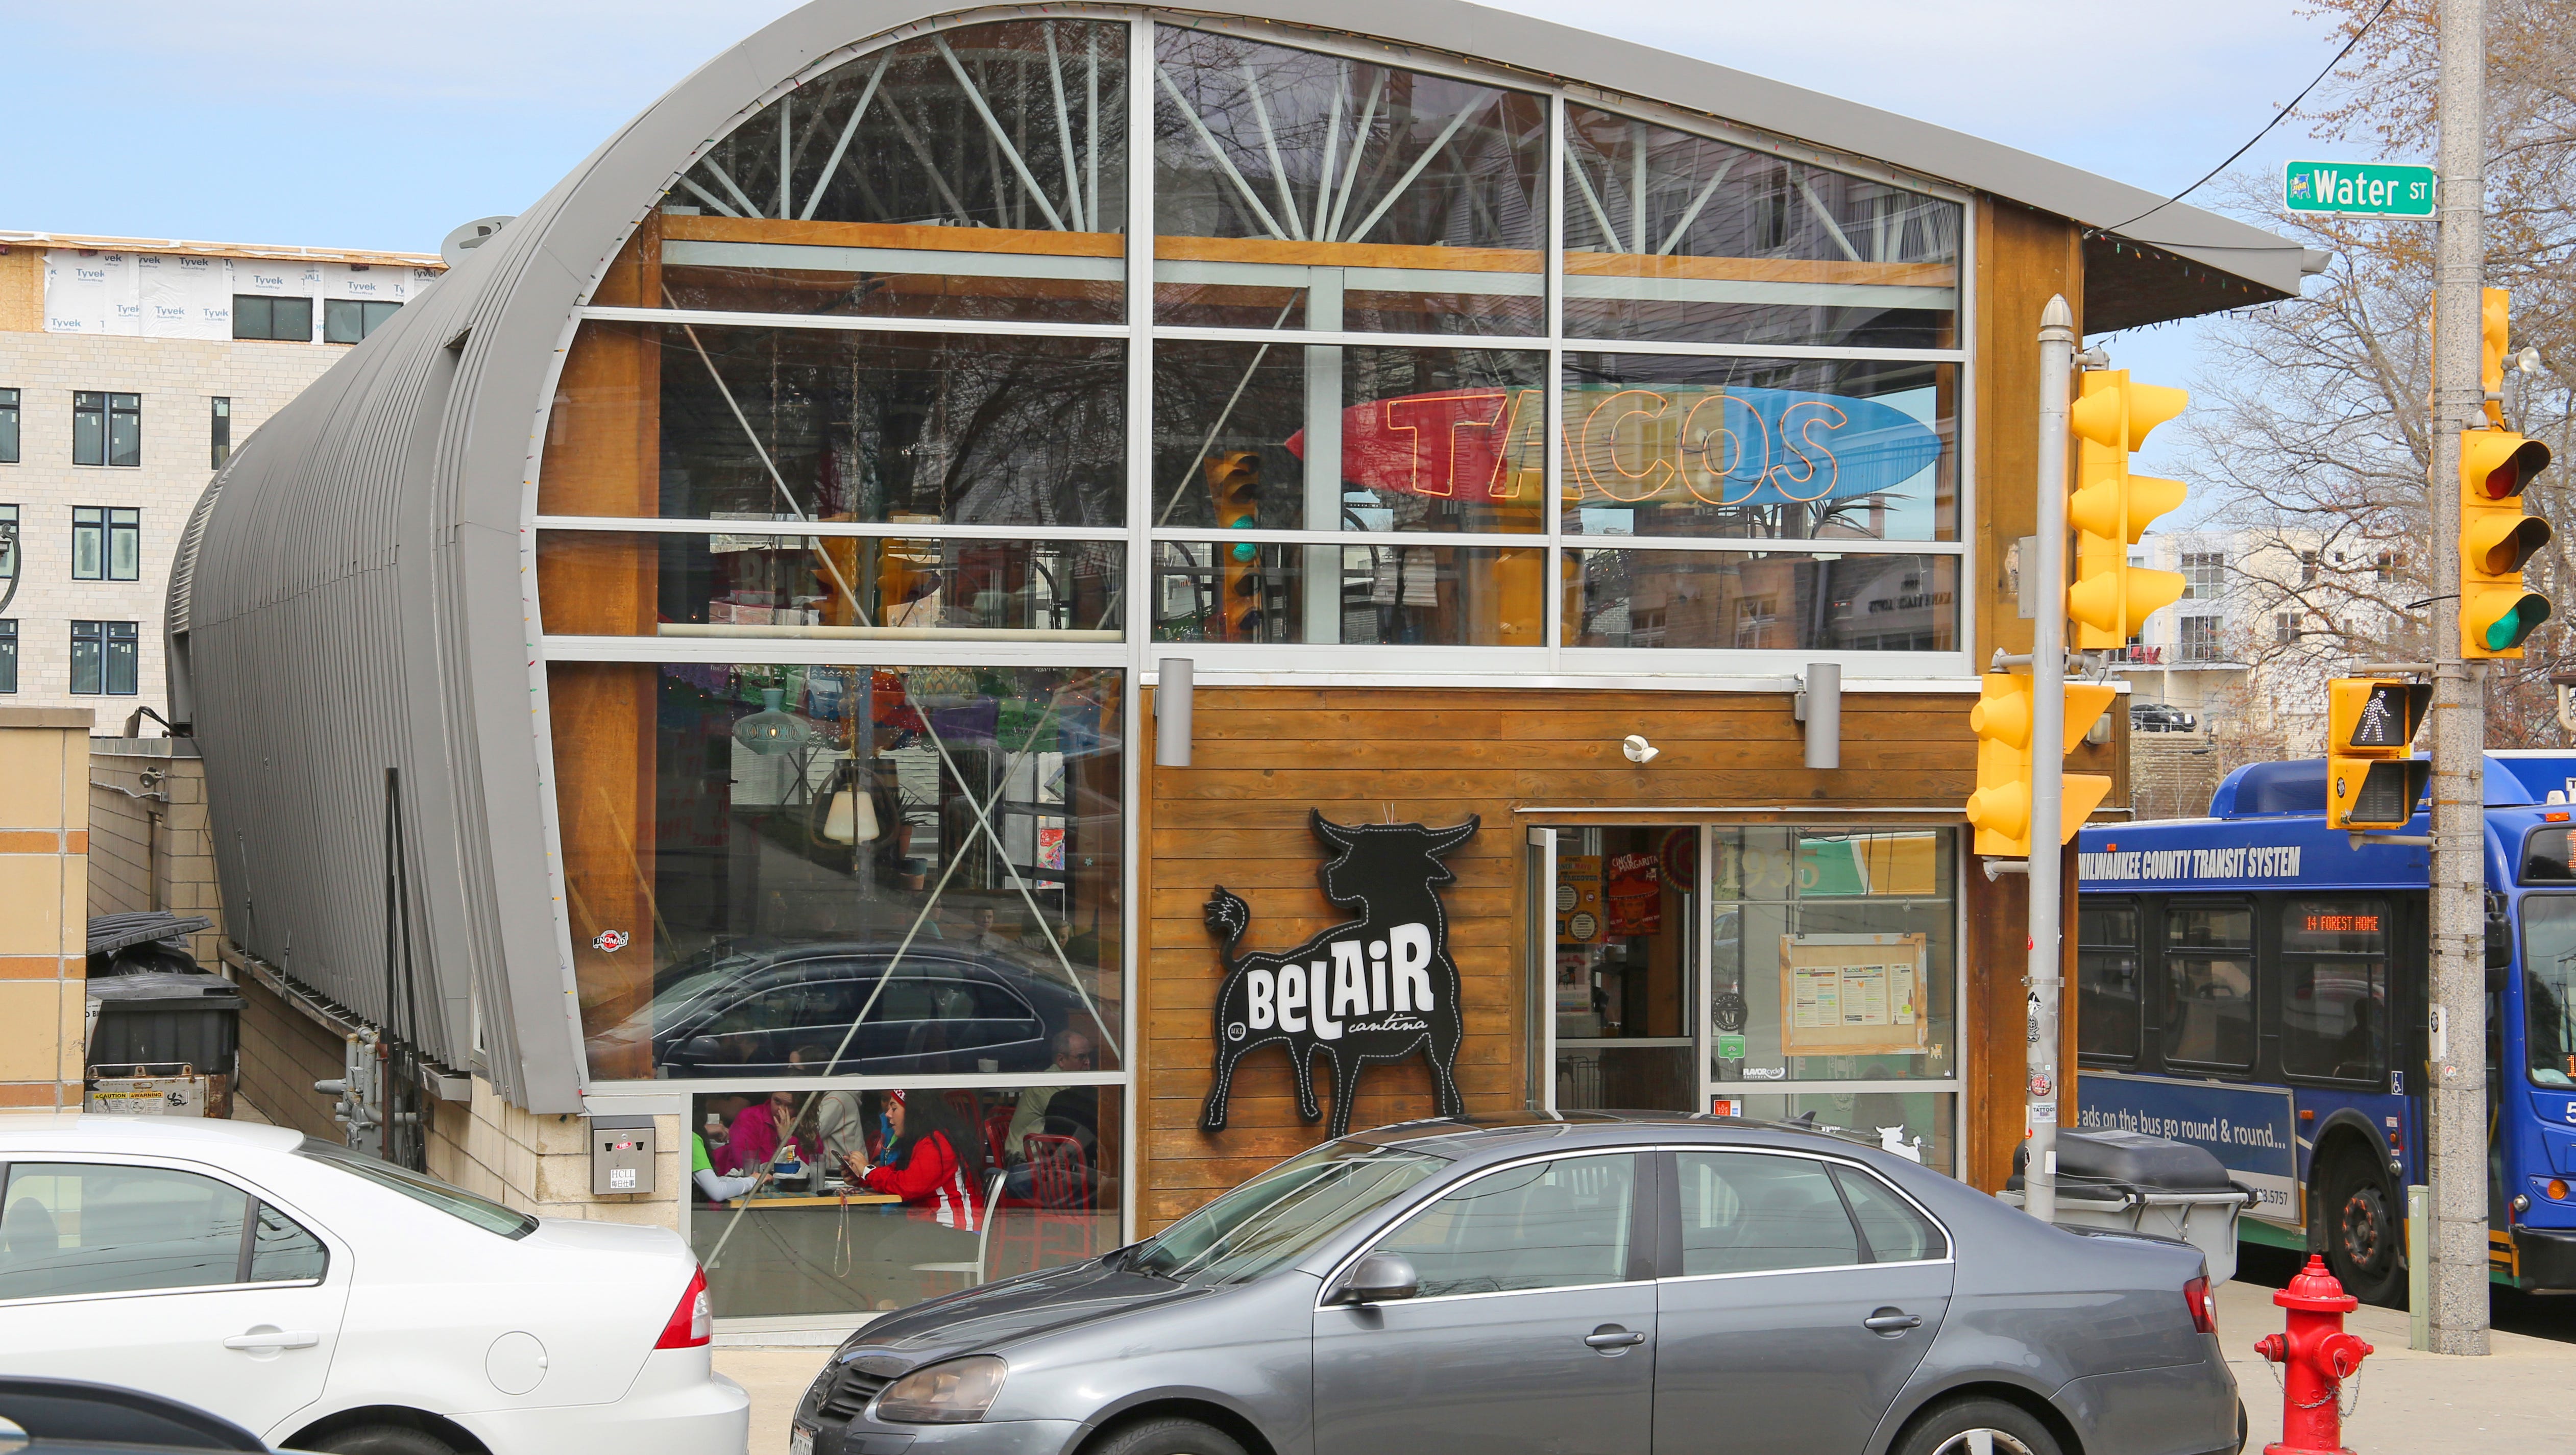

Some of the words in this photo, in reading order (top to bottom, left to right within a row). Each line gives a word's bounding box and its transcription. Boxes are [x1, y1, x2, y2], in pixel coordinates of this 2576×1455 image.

[2314, 169, 2399, 206] Water
[2410, 182, 2427, 200] ST
[179, 257, 208, 266] Tyvek
[254, 275, 283, 285] Tyvek
[348, 281, 376, 291] Tyvek
[155, 306, 185, 315] Tyvek
[51, 318, 81, 328] Tyvek
[1388, 389, 1847, 503] TACOS
[1612, 854, 1633, 867] CINCO
[1618, 855, 1659, 873] MARGARITA
[1720, 843, 1820, 890] 1935
[2078, 851, 2142, 880] MILWAUKEE
[2143, 850, 2191, 880] COUNTY
[2193, 848, 2246, 878] TRANSIT
[2248, 846, 2301, 878] SYSTEM
[2307, 916, 2317, 930] 14
[2321, 916, 2352, 930] FOREST
[2355, 916, 2378, 931] HOME
[600, 937, 625, 945] NOMAD
[1348, 1013, 1428, 1033] cantina
[1231, 1027, 1243, 1035] MKE
[2082, 1104, 2101, 1127] ads
[2103, 1112, 2117, 1127] on
[2119, 1108, 2137, 1132] the
[2140, 1109, 2161, 1135] bus
[2164, 1119, 2178, 1140] go
[2181, 1117, 2217, 1142] round
[2221, 1118, 2231, 1143] &
[2234, 1123, 2286, 1149] round...
[612, 1170, 634, 1178] HCLL
[2255, 1188, 2288, 1205] 3.5757
